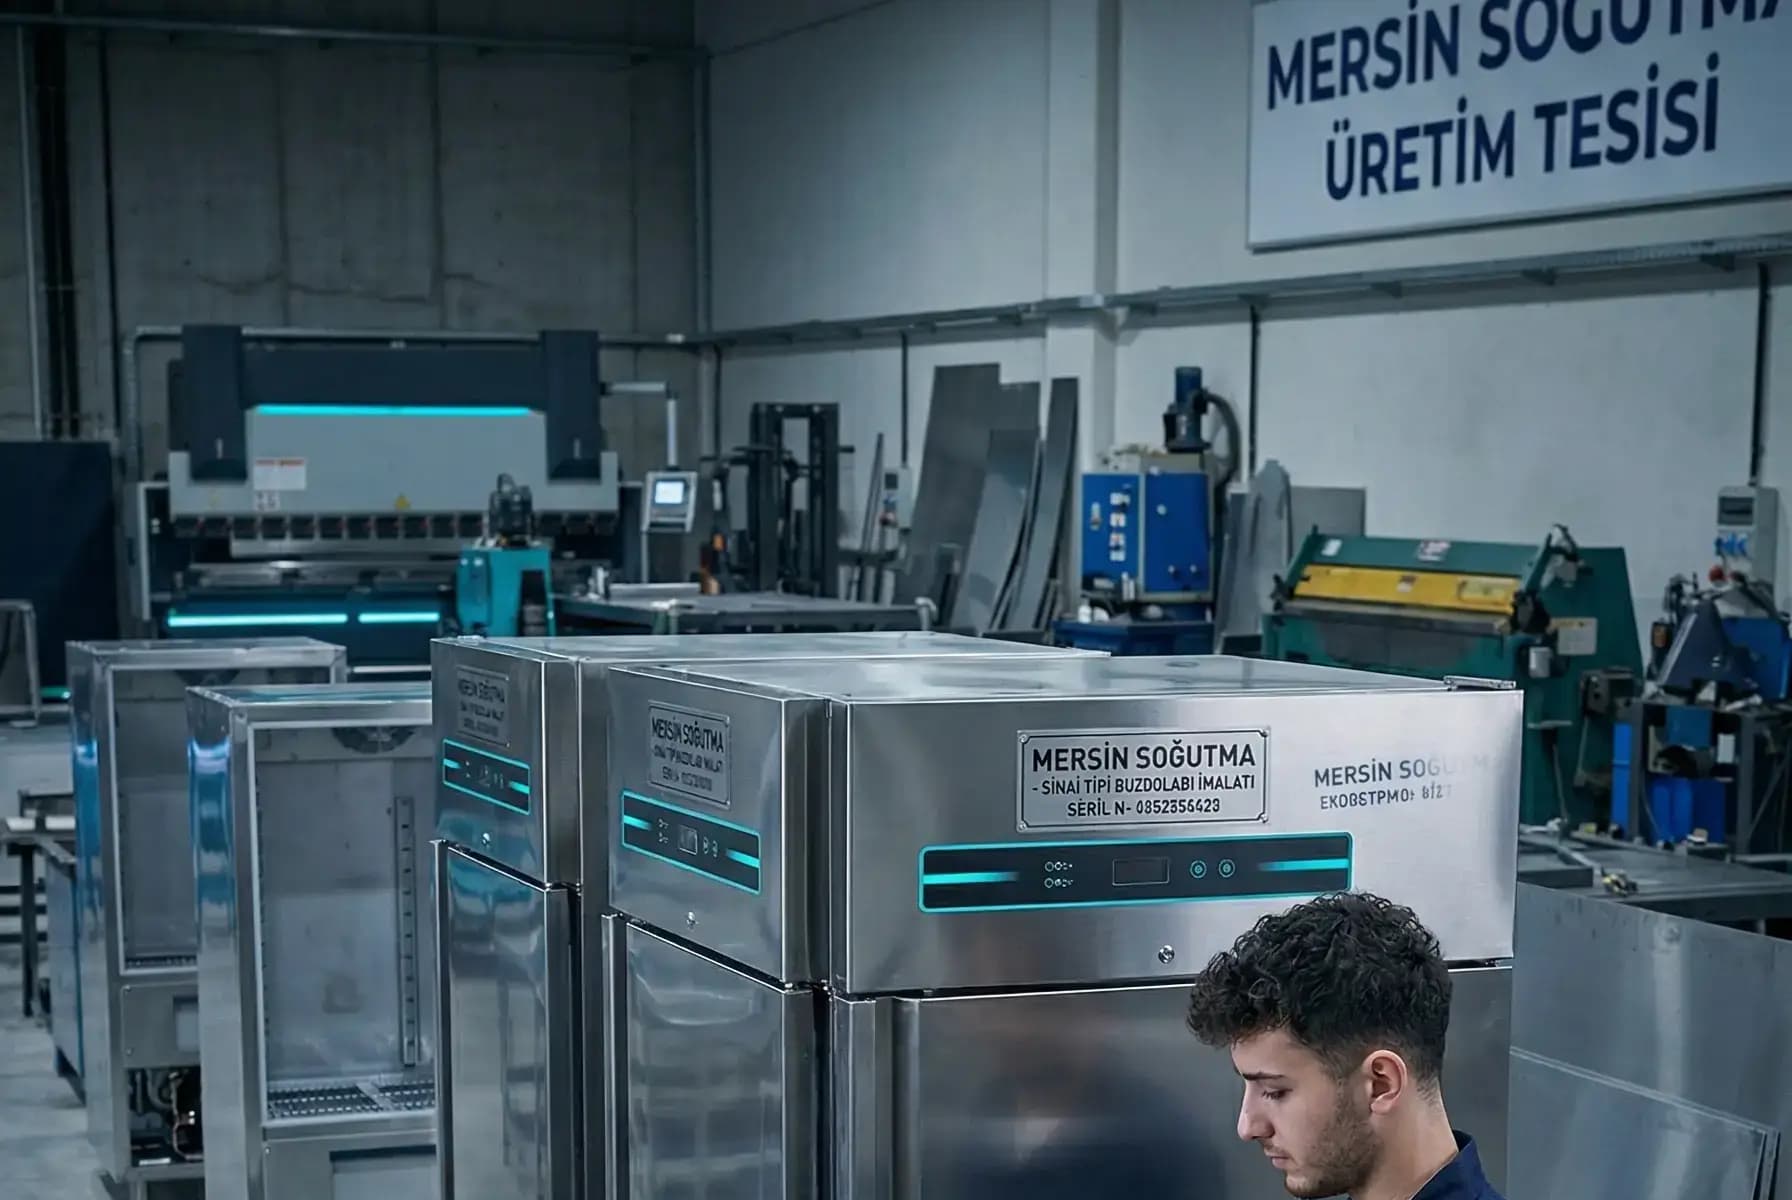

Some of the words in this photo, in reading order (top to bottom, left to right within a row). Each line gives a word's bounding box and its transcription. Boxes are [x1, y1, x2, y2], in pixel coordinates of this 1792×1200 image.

[1267, 3, 1459, 110] MERSİN
[1325, 96, 1516, 200] ÜRETİM
[1534, 52, 1720, 173] TESİSİ
[1032, 741, 1128, 772] MERSİN
[1136, 739, 1256, 769] SOĞUTMA
[1041, 775, 1081, 795] SİNAİ
[1083, 775, 1111, 794] TİPİ
[1115, 776, 1194, 794] BUZDOLABI
[1198, 772, 1255, 791] İMALATI
[1314, 758, 1392, 788] MERSİN
